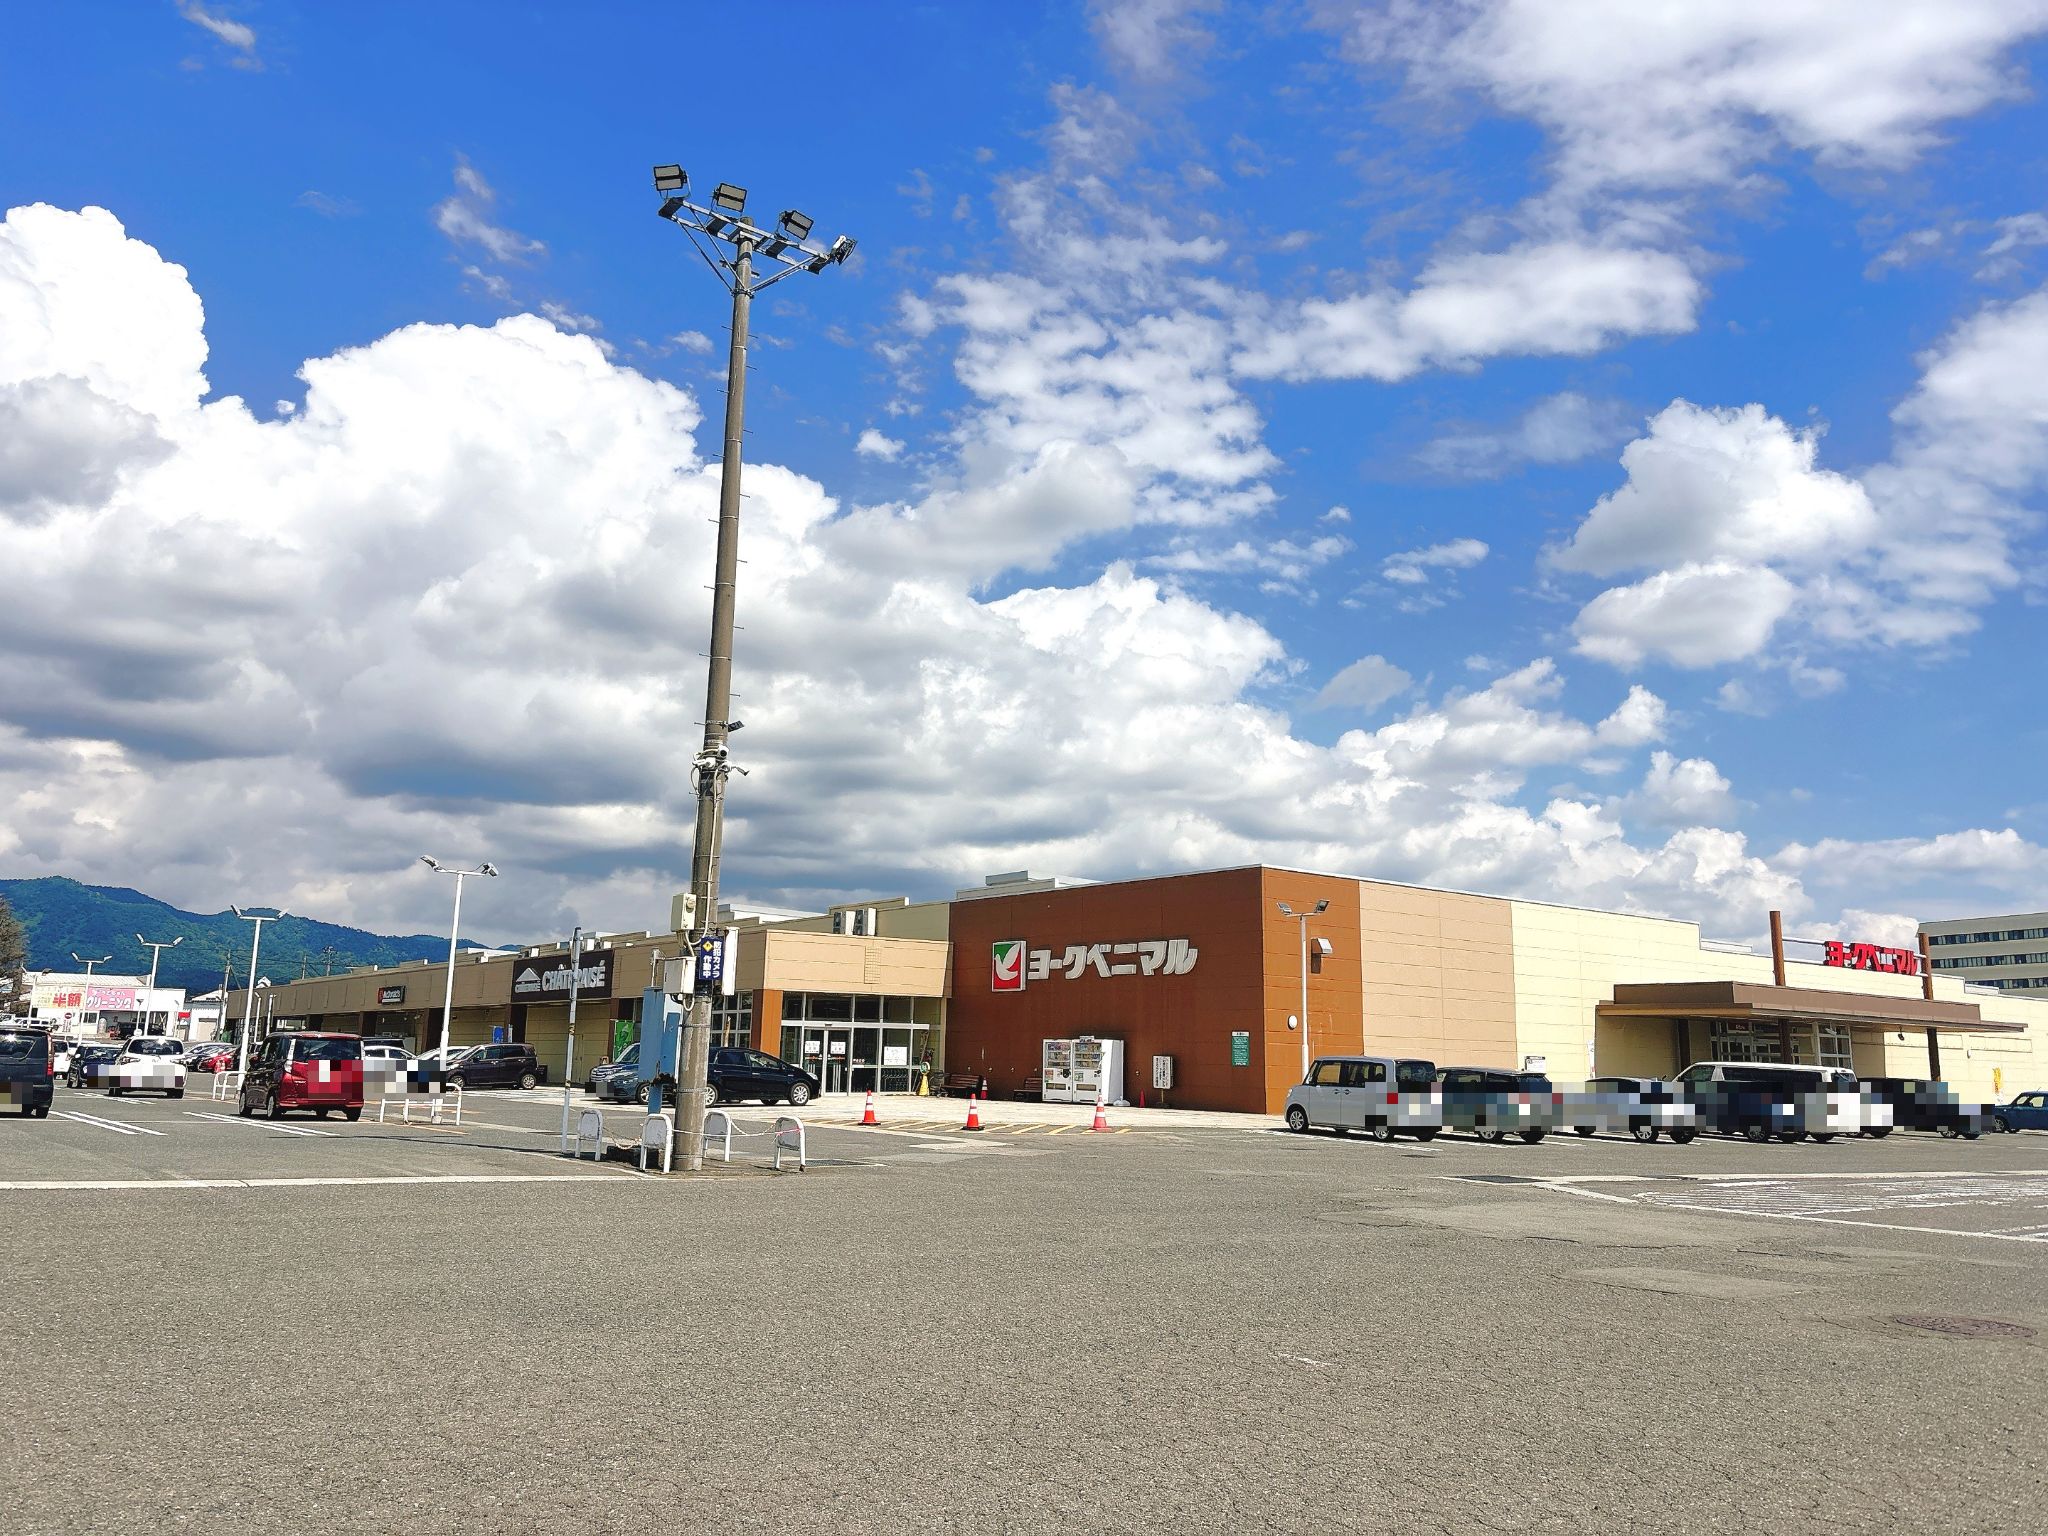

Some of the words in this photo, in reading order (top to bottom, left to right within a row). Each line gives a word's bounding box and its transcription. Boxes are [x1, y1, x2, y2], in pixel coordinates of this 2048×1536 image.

[703, 955, 712, 978] 作動中
[712, 941, 722, 978] 防犯カメラ
[1028, 940, 1198, 980] ヨークベニマル
[1824, 941, 1917, 976] ヨークベニマル
